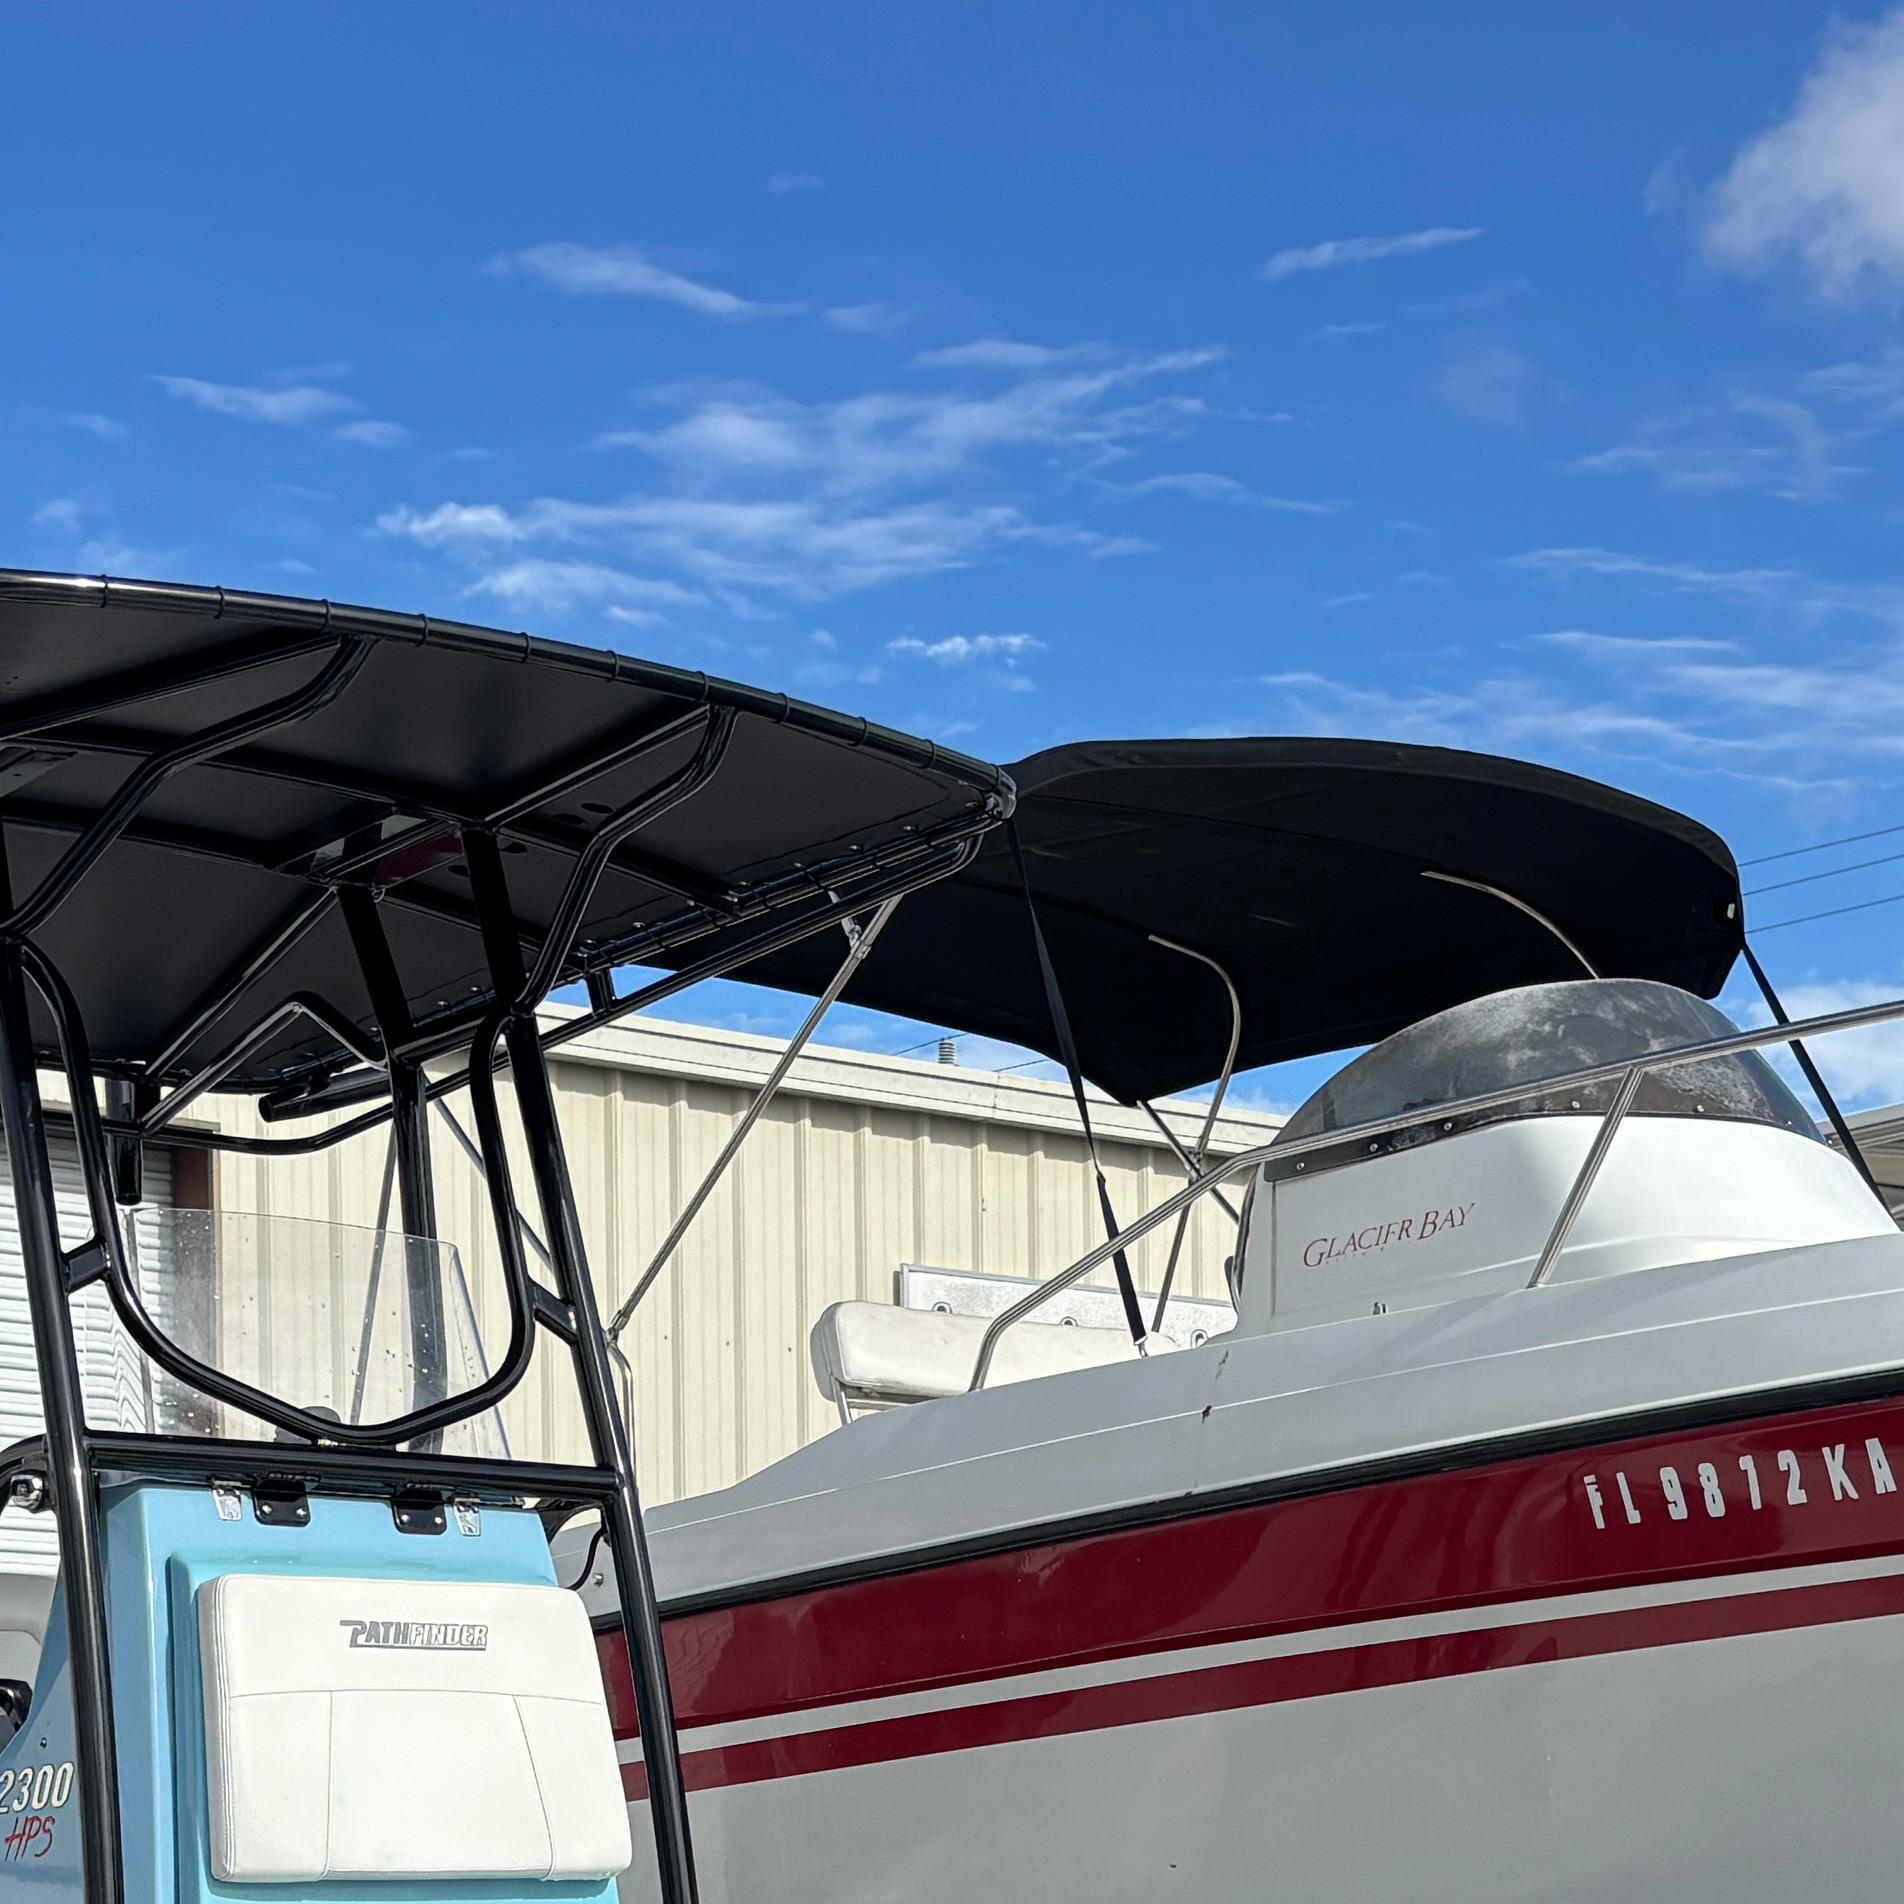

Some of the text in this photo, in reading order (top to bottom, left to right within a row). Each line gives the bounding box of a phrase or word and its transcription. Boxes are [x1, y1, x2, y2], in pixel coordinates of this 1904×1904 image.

[1416, 1202, 1476, 1241] BAY
[1583, 1470, 1642, 1530] FL
[1820, 1436, 1898, 1502] KA
[339, 1619, 489, 1652] PATHFINDER
[4, 1815, 56, 1862] HPS
